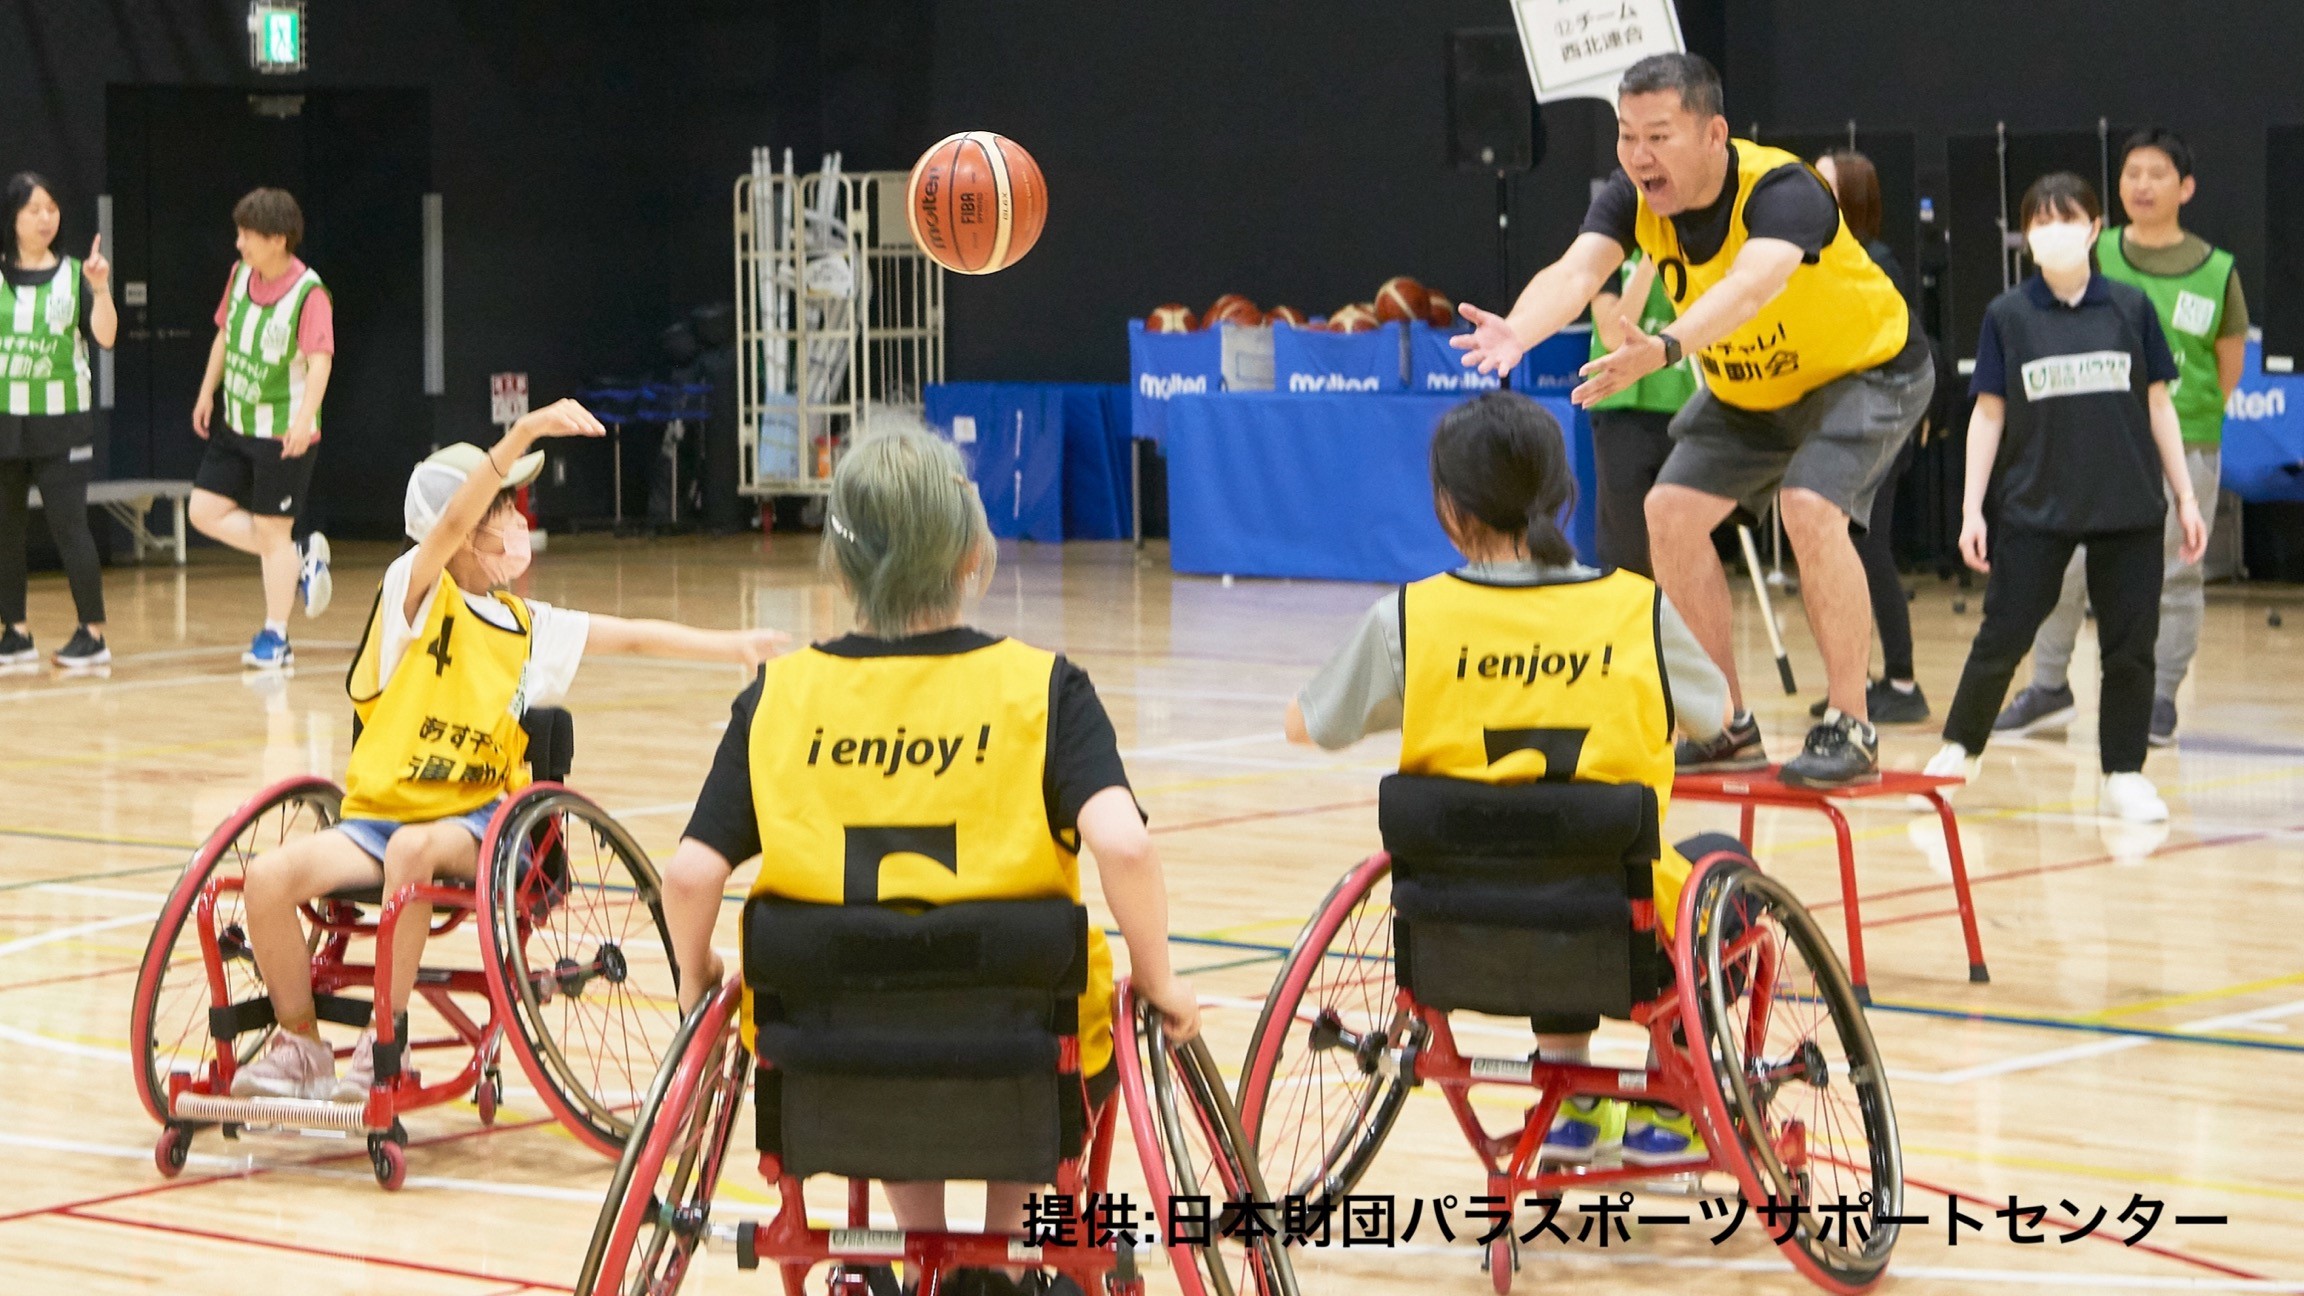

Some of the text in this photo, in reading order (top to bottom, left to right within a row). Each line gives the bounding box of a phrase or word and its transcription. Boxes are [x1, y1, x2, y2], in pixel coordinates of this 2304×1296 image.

[921, 167, 946, 249] molten
[960, 191, 976, 224] FIBA
[427, 616, 454, 677] 4
[1457, 645, 1468, 681] i
[1478, 642, 1592, 688] enjoy
[808, 726, 824, 766] i
[831, 725, 964, 778] enjoy
